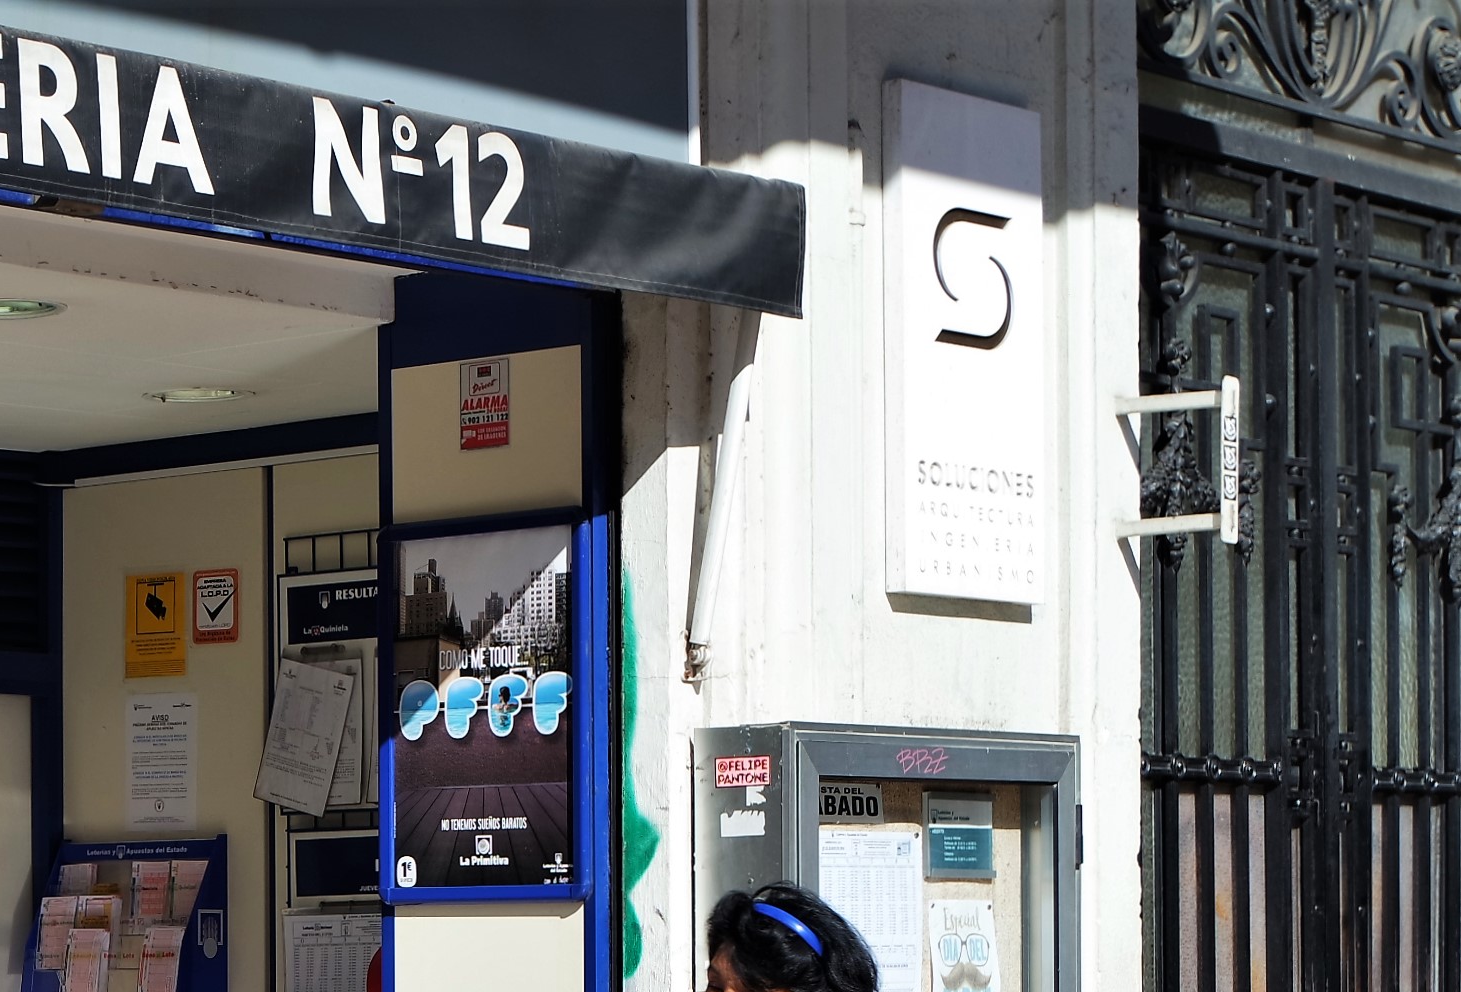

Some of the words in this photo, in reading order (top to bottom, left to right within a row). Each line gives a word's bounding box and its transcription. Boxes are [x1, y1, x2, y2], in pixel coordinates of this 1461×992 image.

[462, 394, 508, 412] ALARMA
[468, 417, 480, 425] 902
[483, 415, 494, 423] 121
[497, 413, 509, 421] 122
[920, 501, 1034, 528] ARQUTECTURA
[921, 530, 1034, 556] INGENERIA
[920, 559, 1034, 585] URBANSMO
[336, 586, 378, 601] RESULTA
[303, 627, 312, 635] La
[320, 624, 349, 633] Quiniela
[439, 649, 468, 671] COMO
[471, 647, 486, 670] ME
[718, 773, 768, 785] PANTONE
[821, 786, 841, 794] STA
[844, 787, 864, 795] DEL
[824, 795, 879, 817] BADO
[441, 819, 450, 831] NO
[451, 818, 477, 831] TENEMOS
[478, 816, 501, 830] SUEÑOS
[502, 817, 528, 829] BARATOS
[460, 856, 471, 866] La
[471, 855, 510, 866] Primitiva
[943, 906, 981, 935] Especial
[970, 938, 987, 961] DEL
